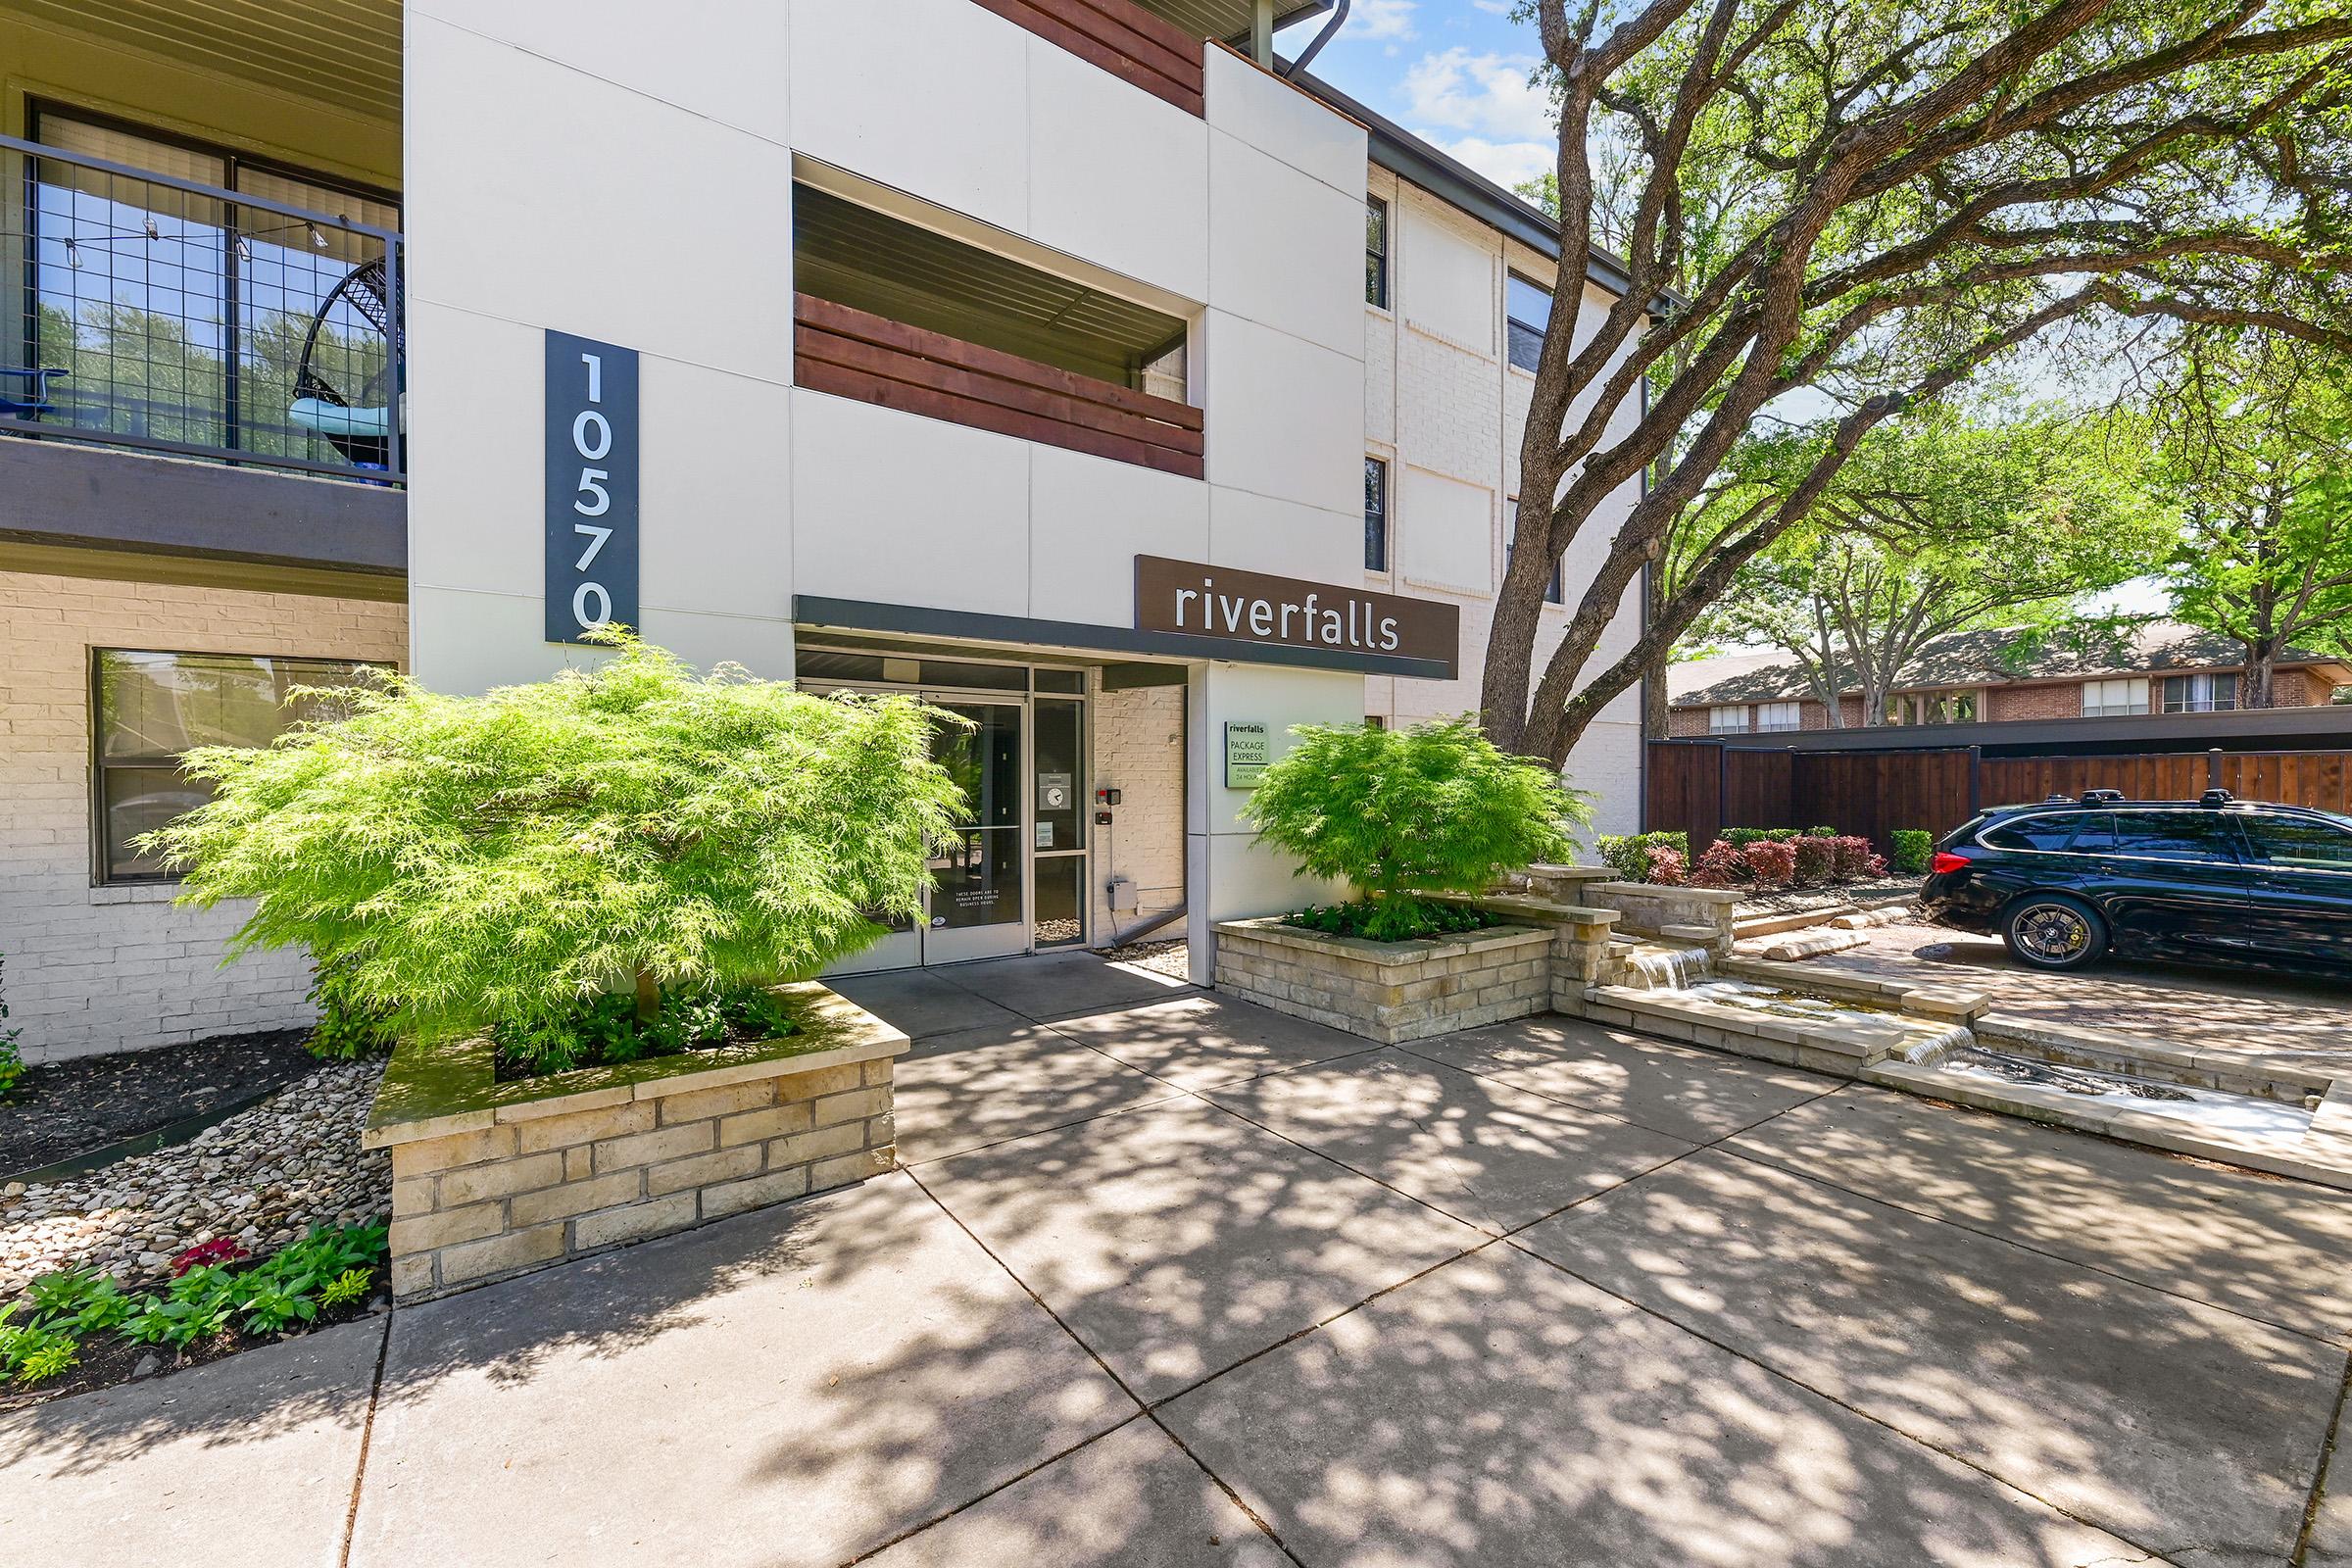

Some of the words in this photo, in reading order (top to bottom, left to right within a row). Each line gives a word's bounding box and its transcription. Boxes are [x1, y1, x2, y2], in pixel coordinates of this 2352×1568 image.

[572, 353, 613, 631] 10570
[1175, 577, 1398, 652] riverfalls
[1229, 723, 1264, 734] riverfalls
[1230, 741, 1264, 750] PACKAGE
[1233, 753, 1263, 761] EXPRESS
